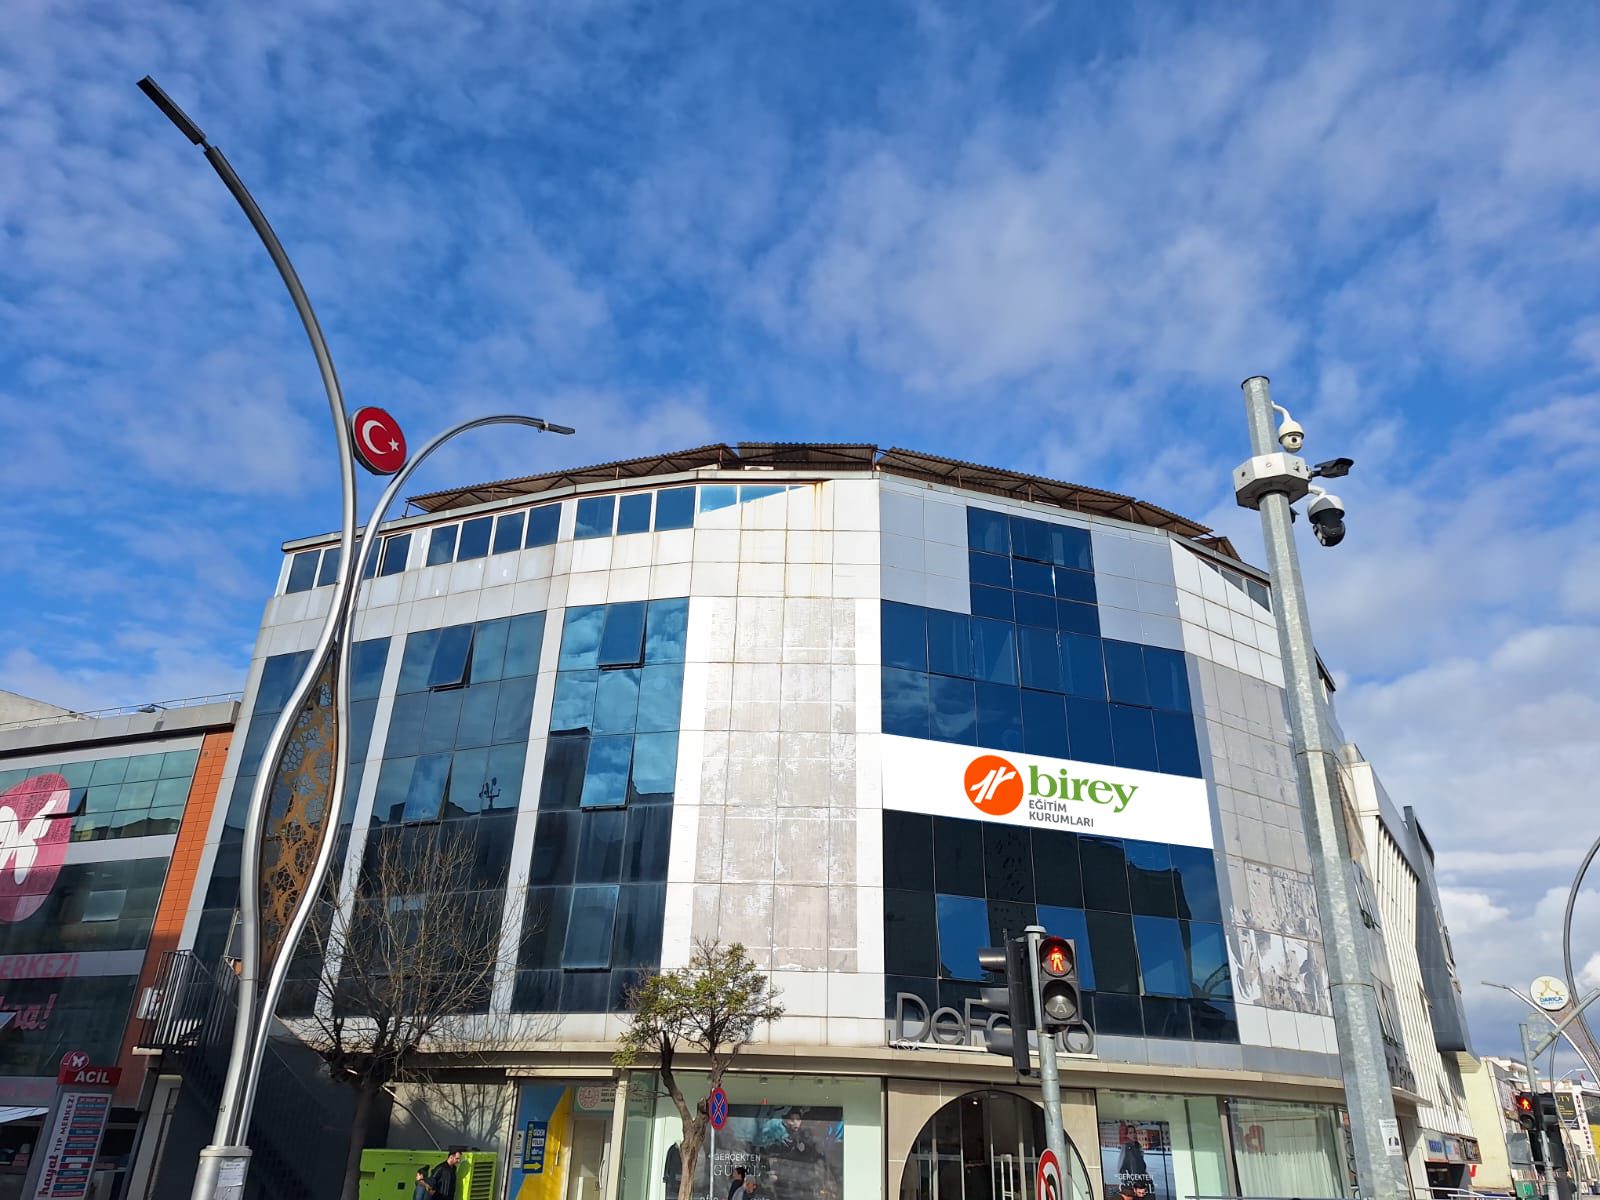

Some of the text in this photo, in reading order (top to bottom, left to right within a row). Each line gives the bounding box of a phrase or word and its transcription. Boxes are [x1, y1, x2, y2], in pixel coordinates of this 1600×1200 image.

[1028, 765, 1139, 813] birey
[1028, 798, 1067, 813] EĞİTİM
[1028, 811, 1094, 828] KURUMLARI
[74, 1069, 110, 1084] ACİL
